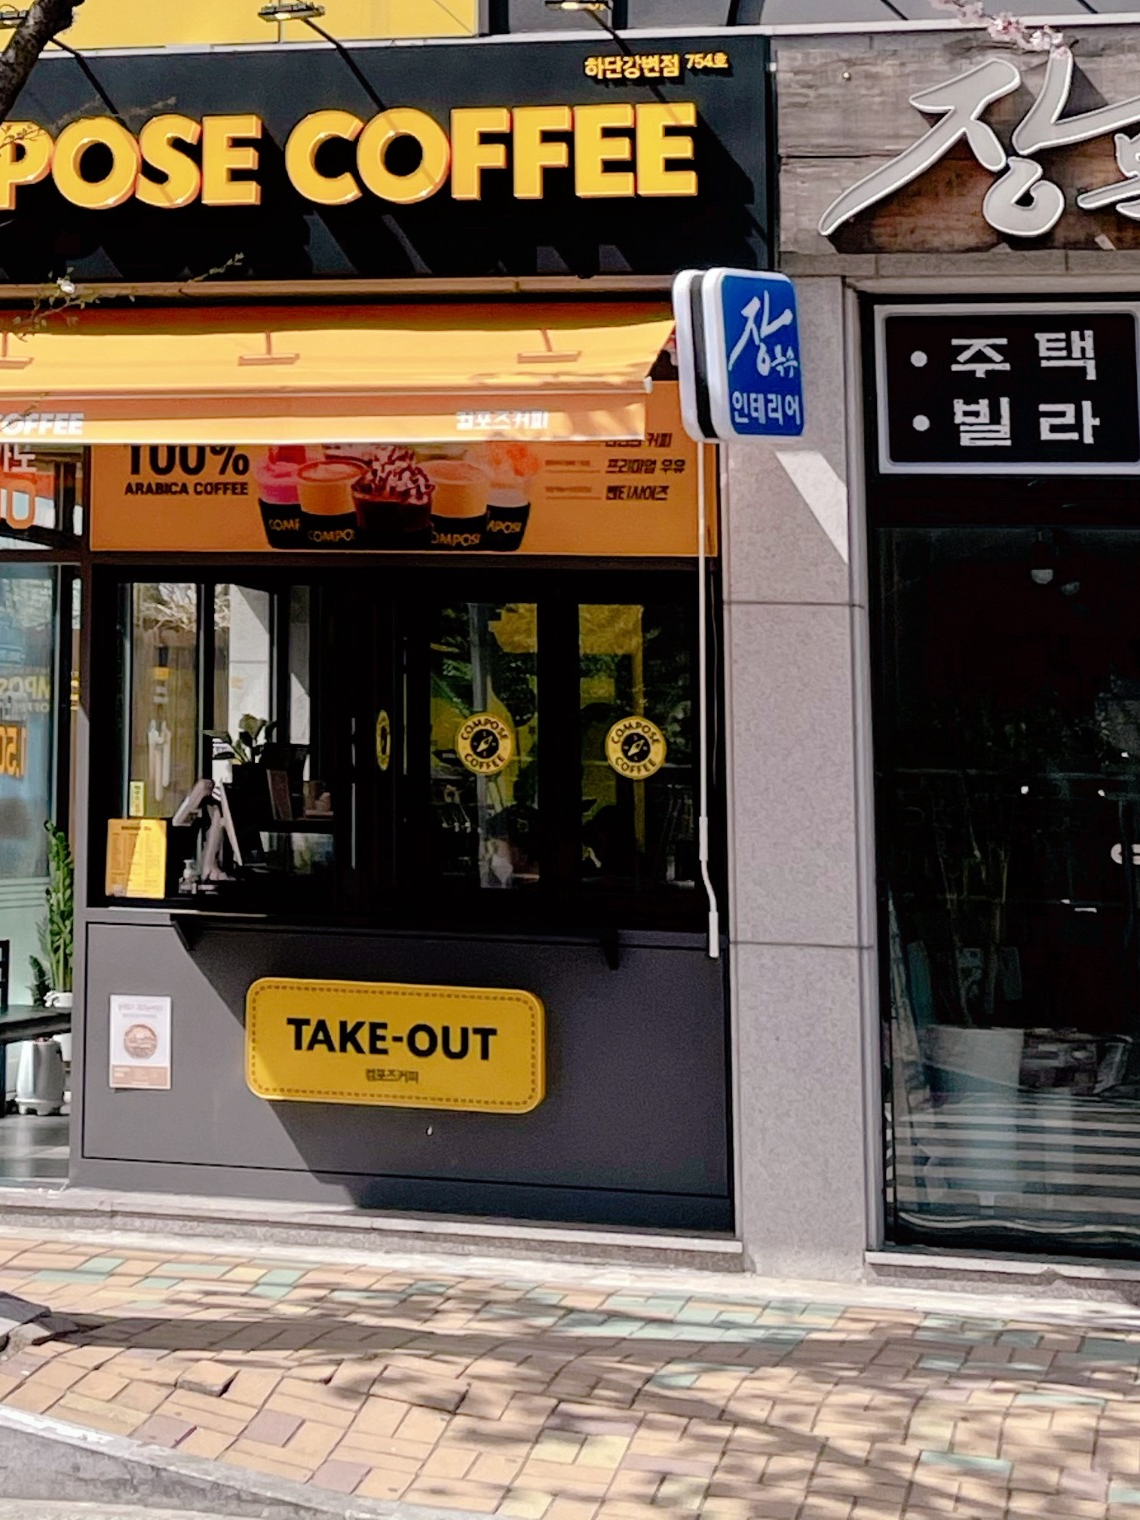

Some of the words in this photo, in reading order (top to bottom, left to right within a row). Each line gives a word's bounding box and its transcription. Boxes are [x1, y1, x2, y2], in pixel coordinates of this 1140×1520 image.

[585, 54, 680, 79] 하단강변점
[684, 51, 729, 69] 754호
[285, 102, 698, 206] COFFEE
[732, 391, 801, 426] 인테리어
[646, 432, 673, 448] 커피
[661, 459, 686, 474] 우유
[124, 482, 190, 496] ARABICA
[193, 482, 249, 496] COFFEE
[460, 718, 509, 741] COMPOSE
[611, 721, 661, 744] COMPOSE
[464, 752, 507, 771] COFFEE
[615, 756, 658, 775] COFFEE
[286, 1017, 498, 1061] TAKE-OUT
